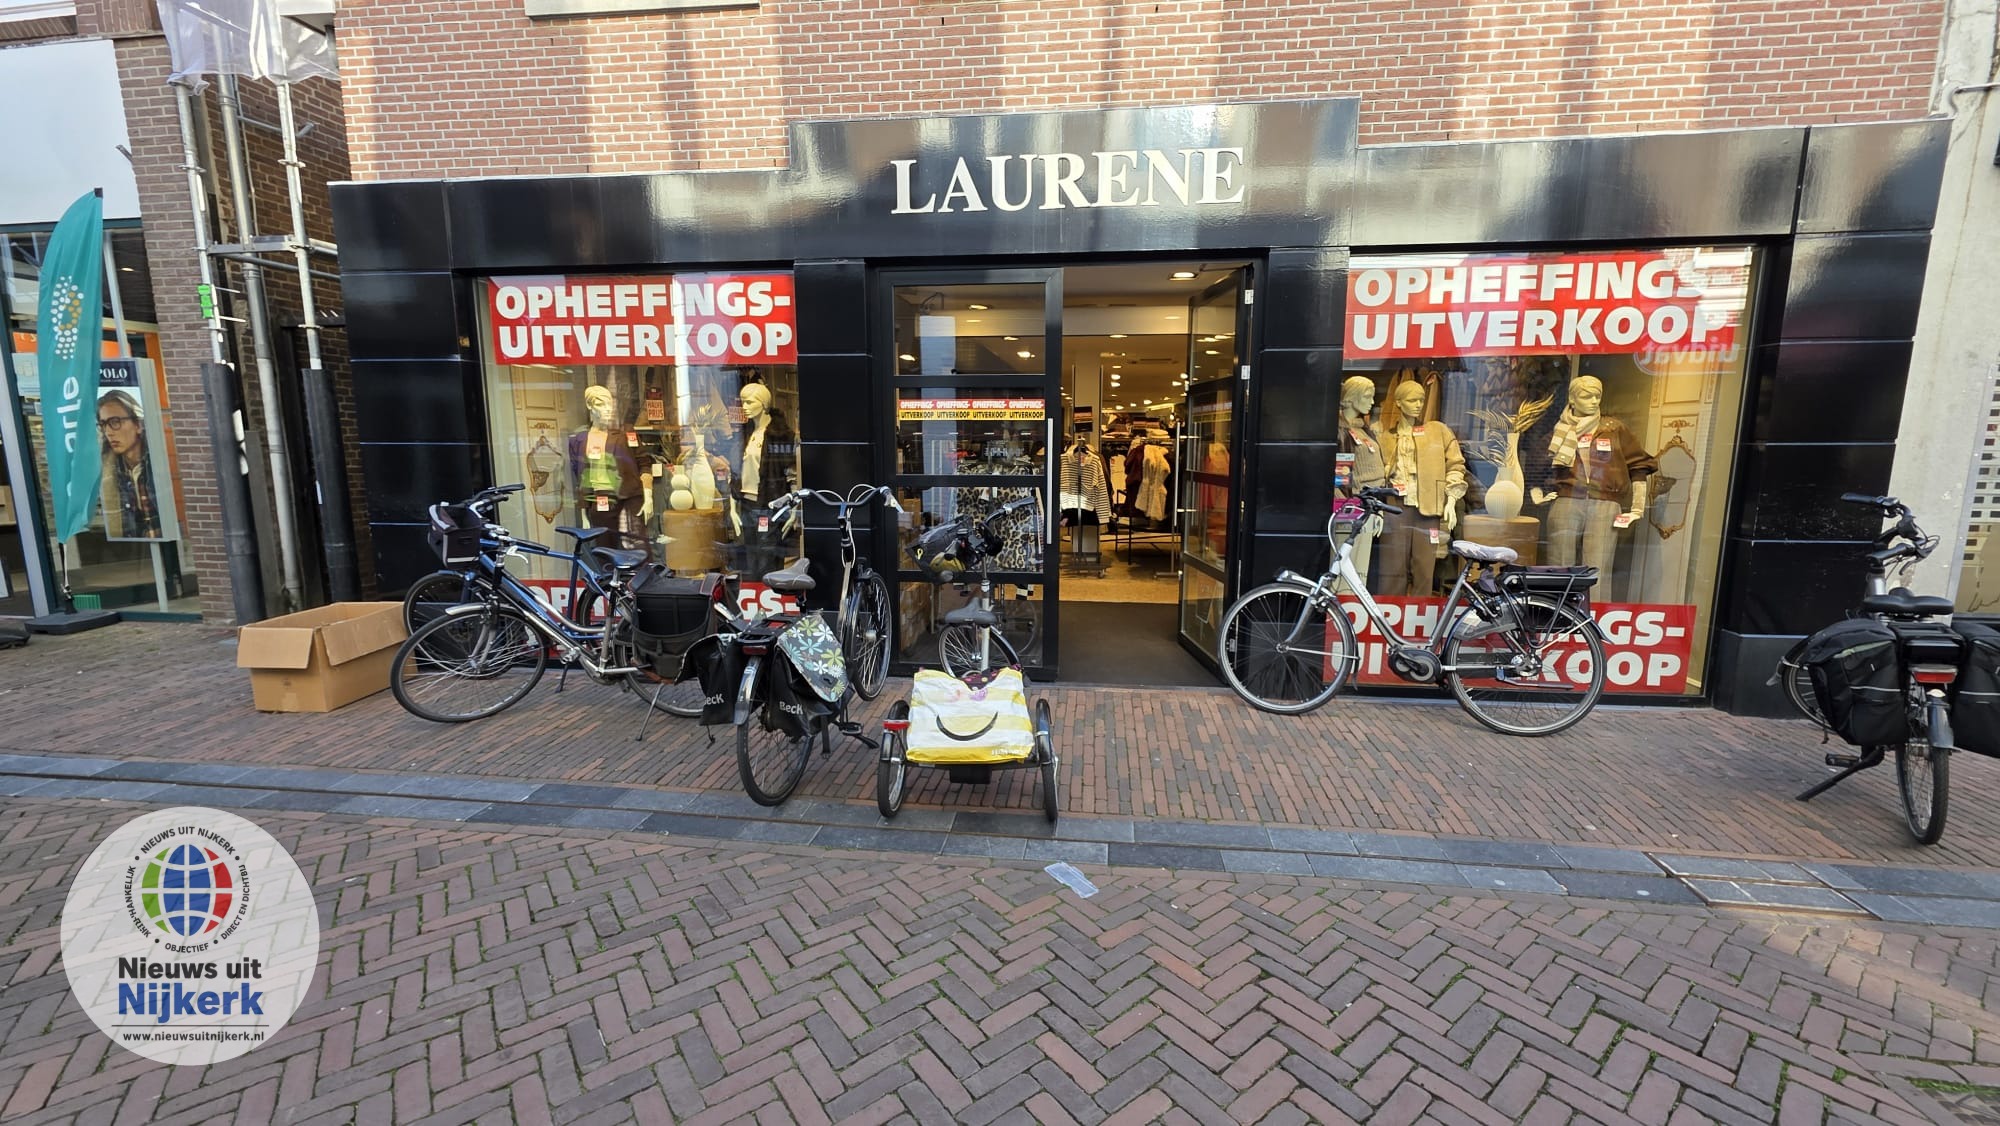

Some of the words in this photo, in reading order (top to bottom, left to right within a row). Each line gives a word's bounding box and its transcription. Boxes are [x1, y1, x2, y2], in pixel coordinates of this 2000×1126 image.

[890, 147, 1245, 215] LAURENE
[495, 281, 791, 319] OPHEFFINGS-
[499, 323, 793, 358] UITVERKOOP
[1353, 305, 1727, 351] UITVERKOOP
[901, 411, 934, 419] UITVERKOOP
[937, 411, 970, 419] UITVERKOOP
[973, 411, 1007, 419] UITVERKOOP
[1009, 411, 1044, 419] UITVERKOOP
